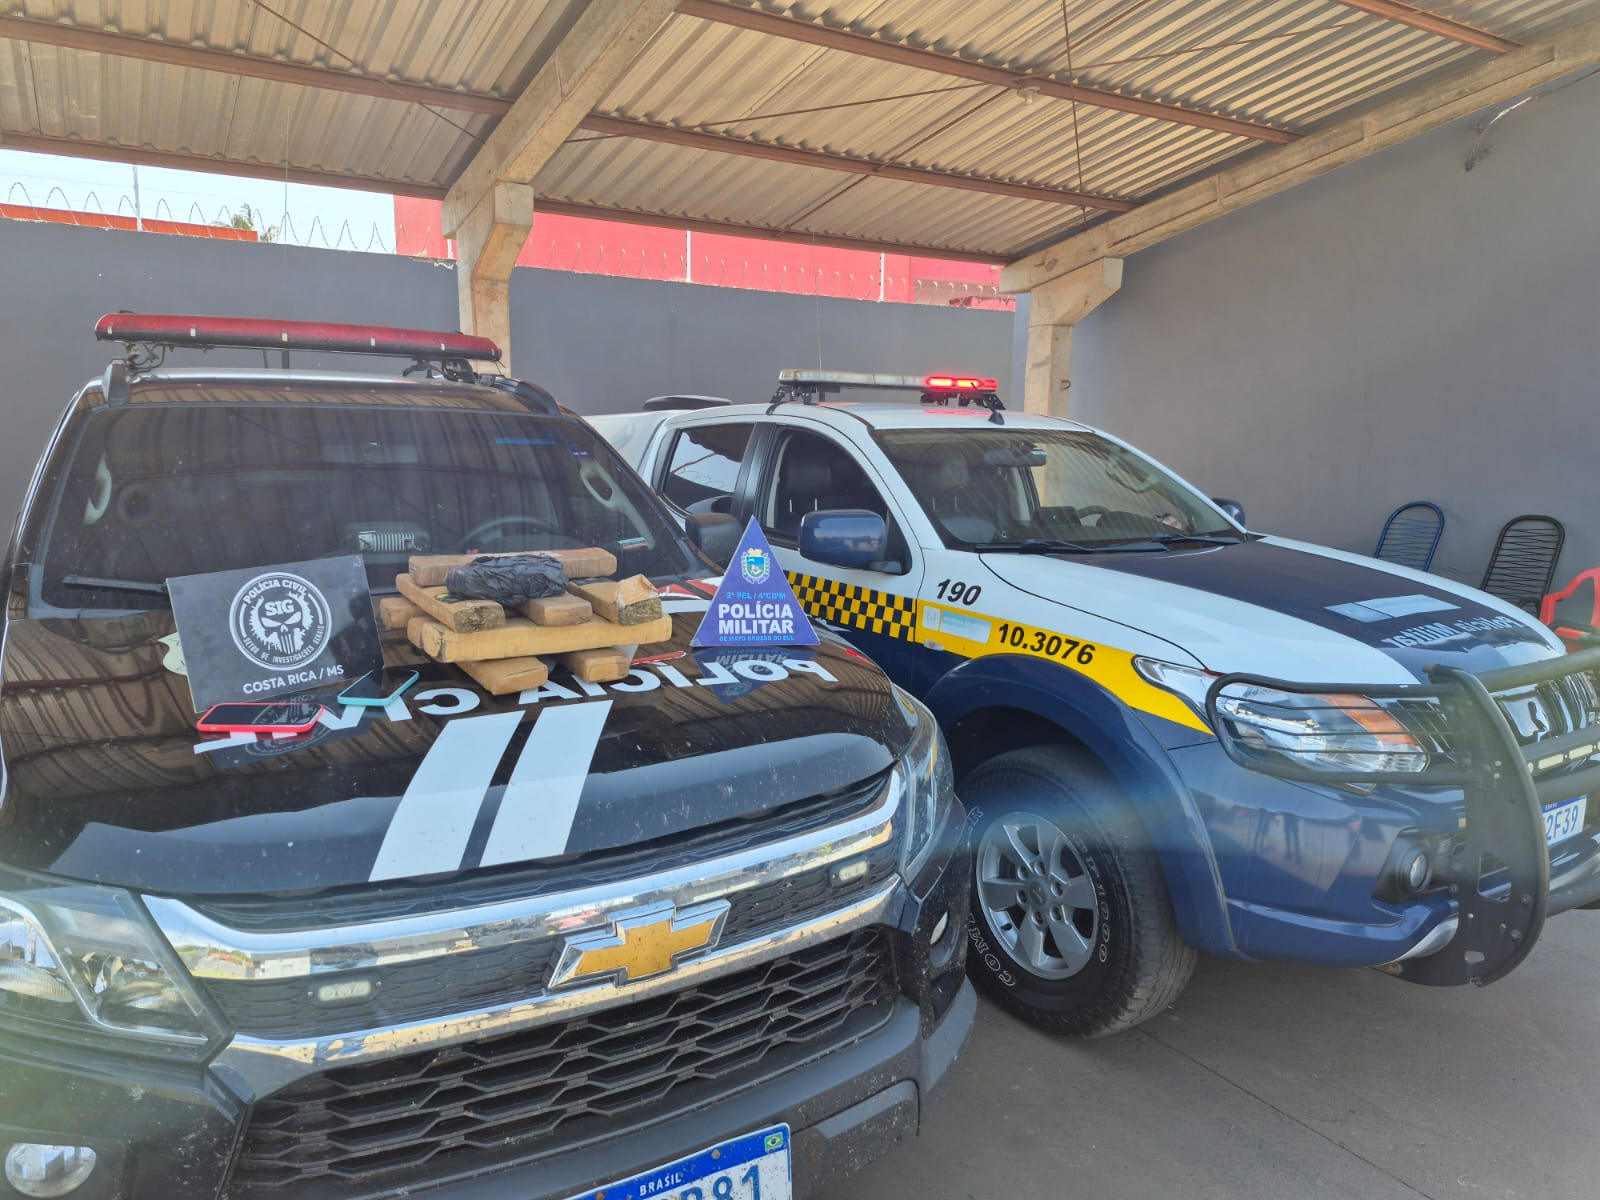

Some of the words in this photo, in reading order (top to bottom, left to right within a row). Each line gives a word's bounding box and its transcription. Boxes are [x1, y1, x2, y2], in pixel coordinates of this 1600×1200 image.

[282, 580, 307, 593] CIVIL
[936, 578, 982, 606] 190
[264, 599, 295, 617] SIG
[718, 600, 794, 619] POLÍCIA
[718, 619, 795, 634] MILITAR
[998, 623, 1097, 665] 10.3076
[242, 677, 286, 694] COSTA
[287, 670, 317, 686] RICA
[326, 664, 344, 677] MS
[639, 1173, 682, 1196] BRASIL
